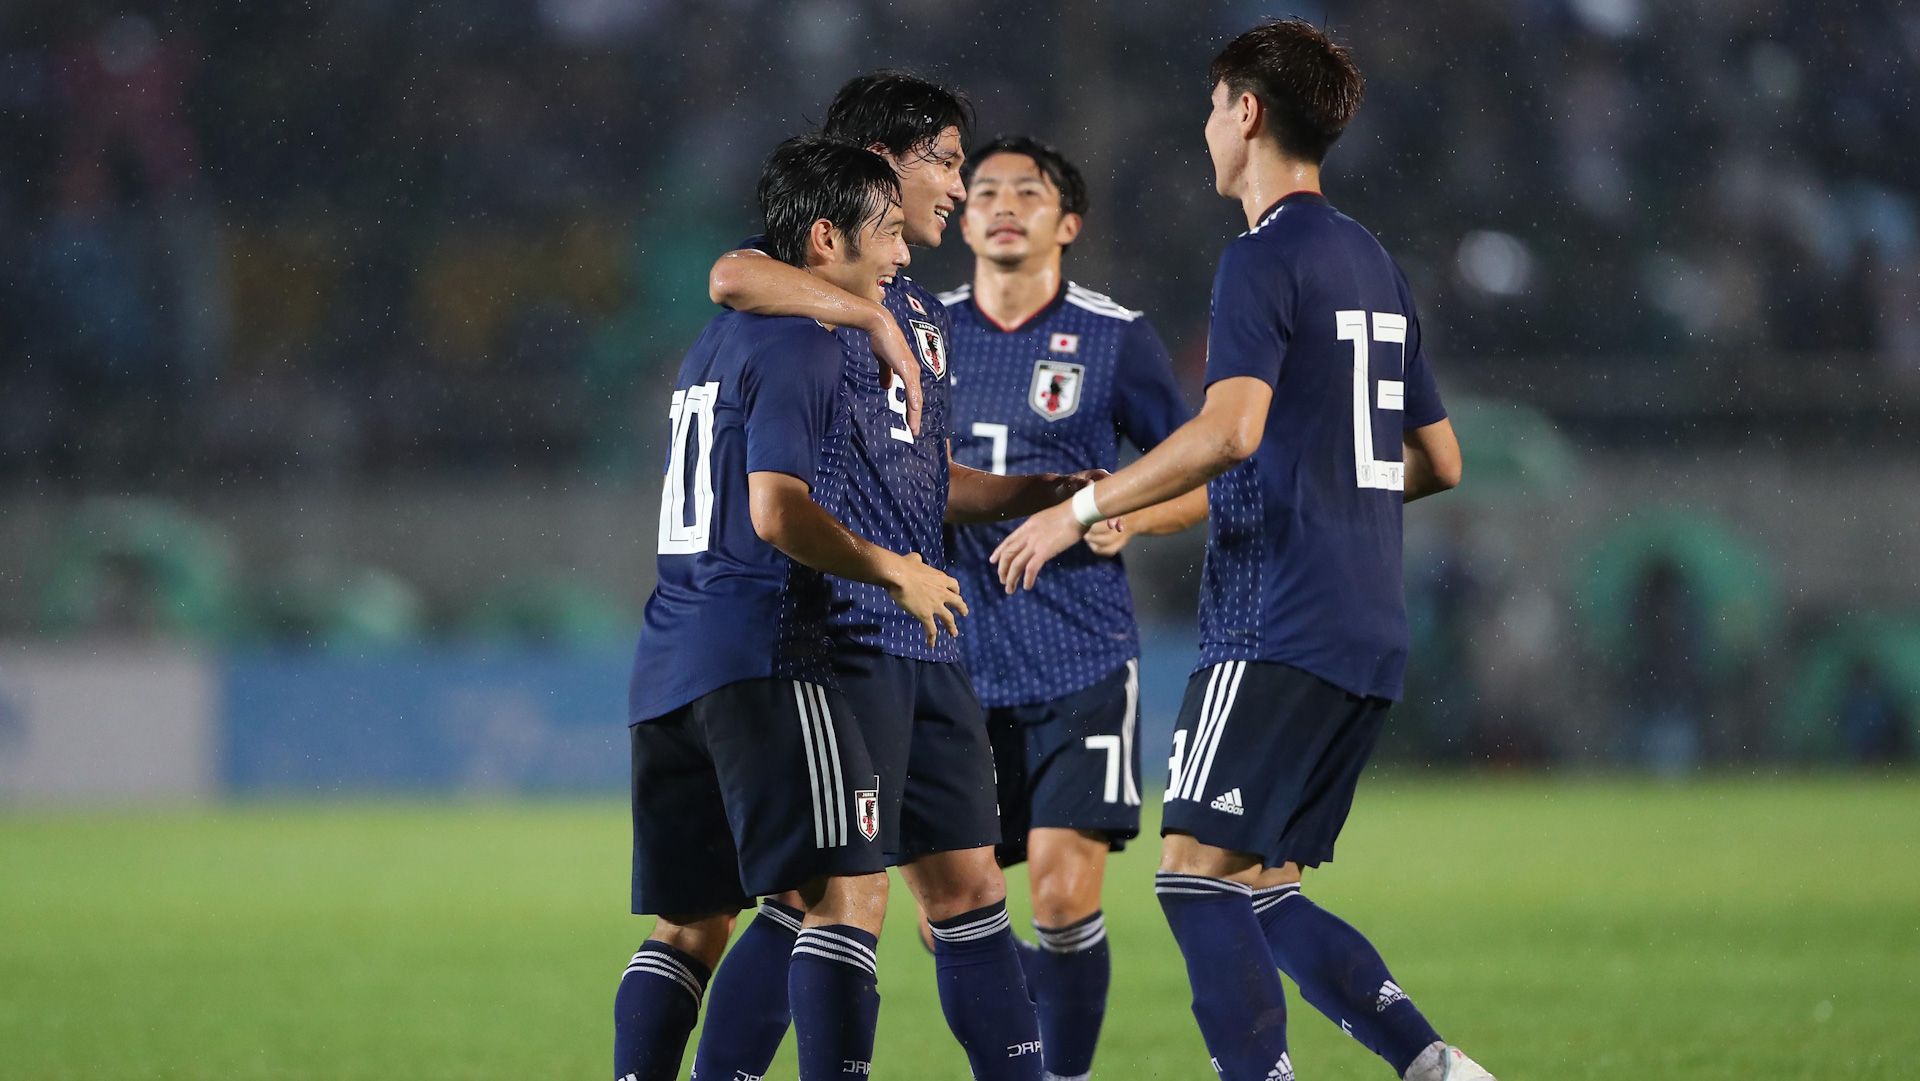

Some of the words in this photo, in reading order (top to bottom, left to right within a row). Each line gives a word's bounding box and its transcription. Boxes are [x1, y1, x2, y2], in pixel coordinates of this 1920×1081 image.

[657, 381, 720, 555] 10
[972, 422, 1008, 476] 7
[1085, 735, 1121, 803] 7
[1210, 800, 1245, 816] adidas
